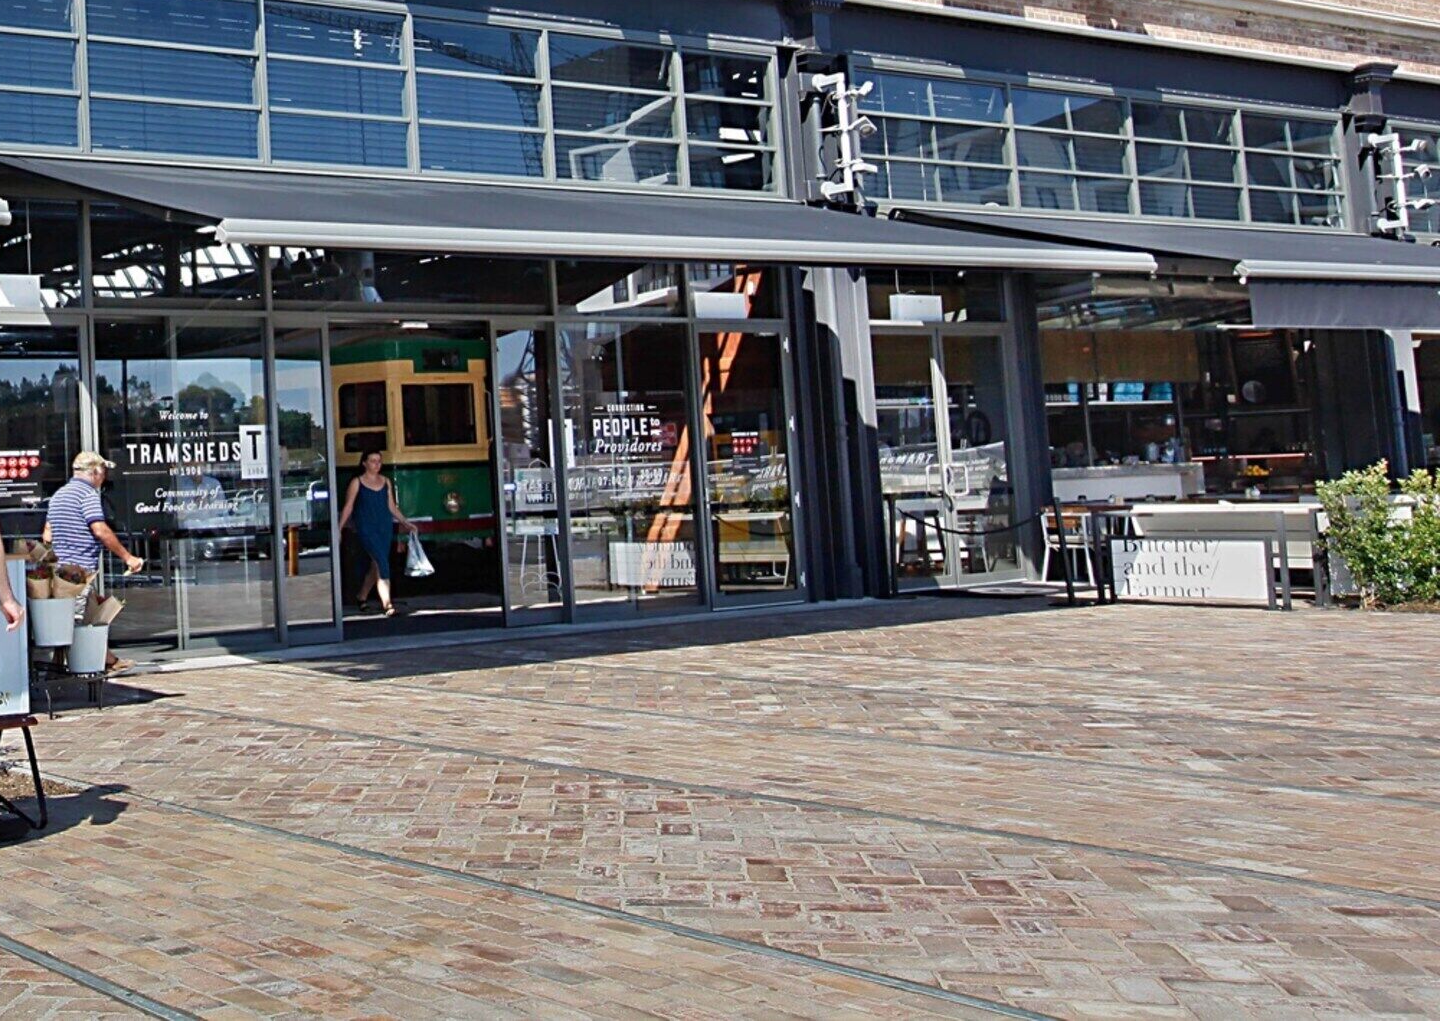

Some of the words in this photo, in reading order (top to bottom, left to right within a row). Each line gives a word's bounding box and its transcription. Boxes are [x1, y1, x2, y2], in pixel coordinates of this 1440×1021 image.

[159, 410, 198, 420] Welcome
[199, 410, 209, 420] to
[592, 418, 649, 437] PEOPLE
[649, 417, 661, 427] to
[126, 442, 241, 465] TRAMSHEDS
[246, 430, 262, 460] T
[594, 437, 663, 454] Providores
[155, 487, 209, 499] Community
[209, 486, 220, 498] of
[135, 502, 159, 513] Good
[162, 501, 185, 512] Food
[198, 500, 239, 512] Learning
[1123, 556, 1166, 576] and
[1124, 578, 1211, 598] Farmer
